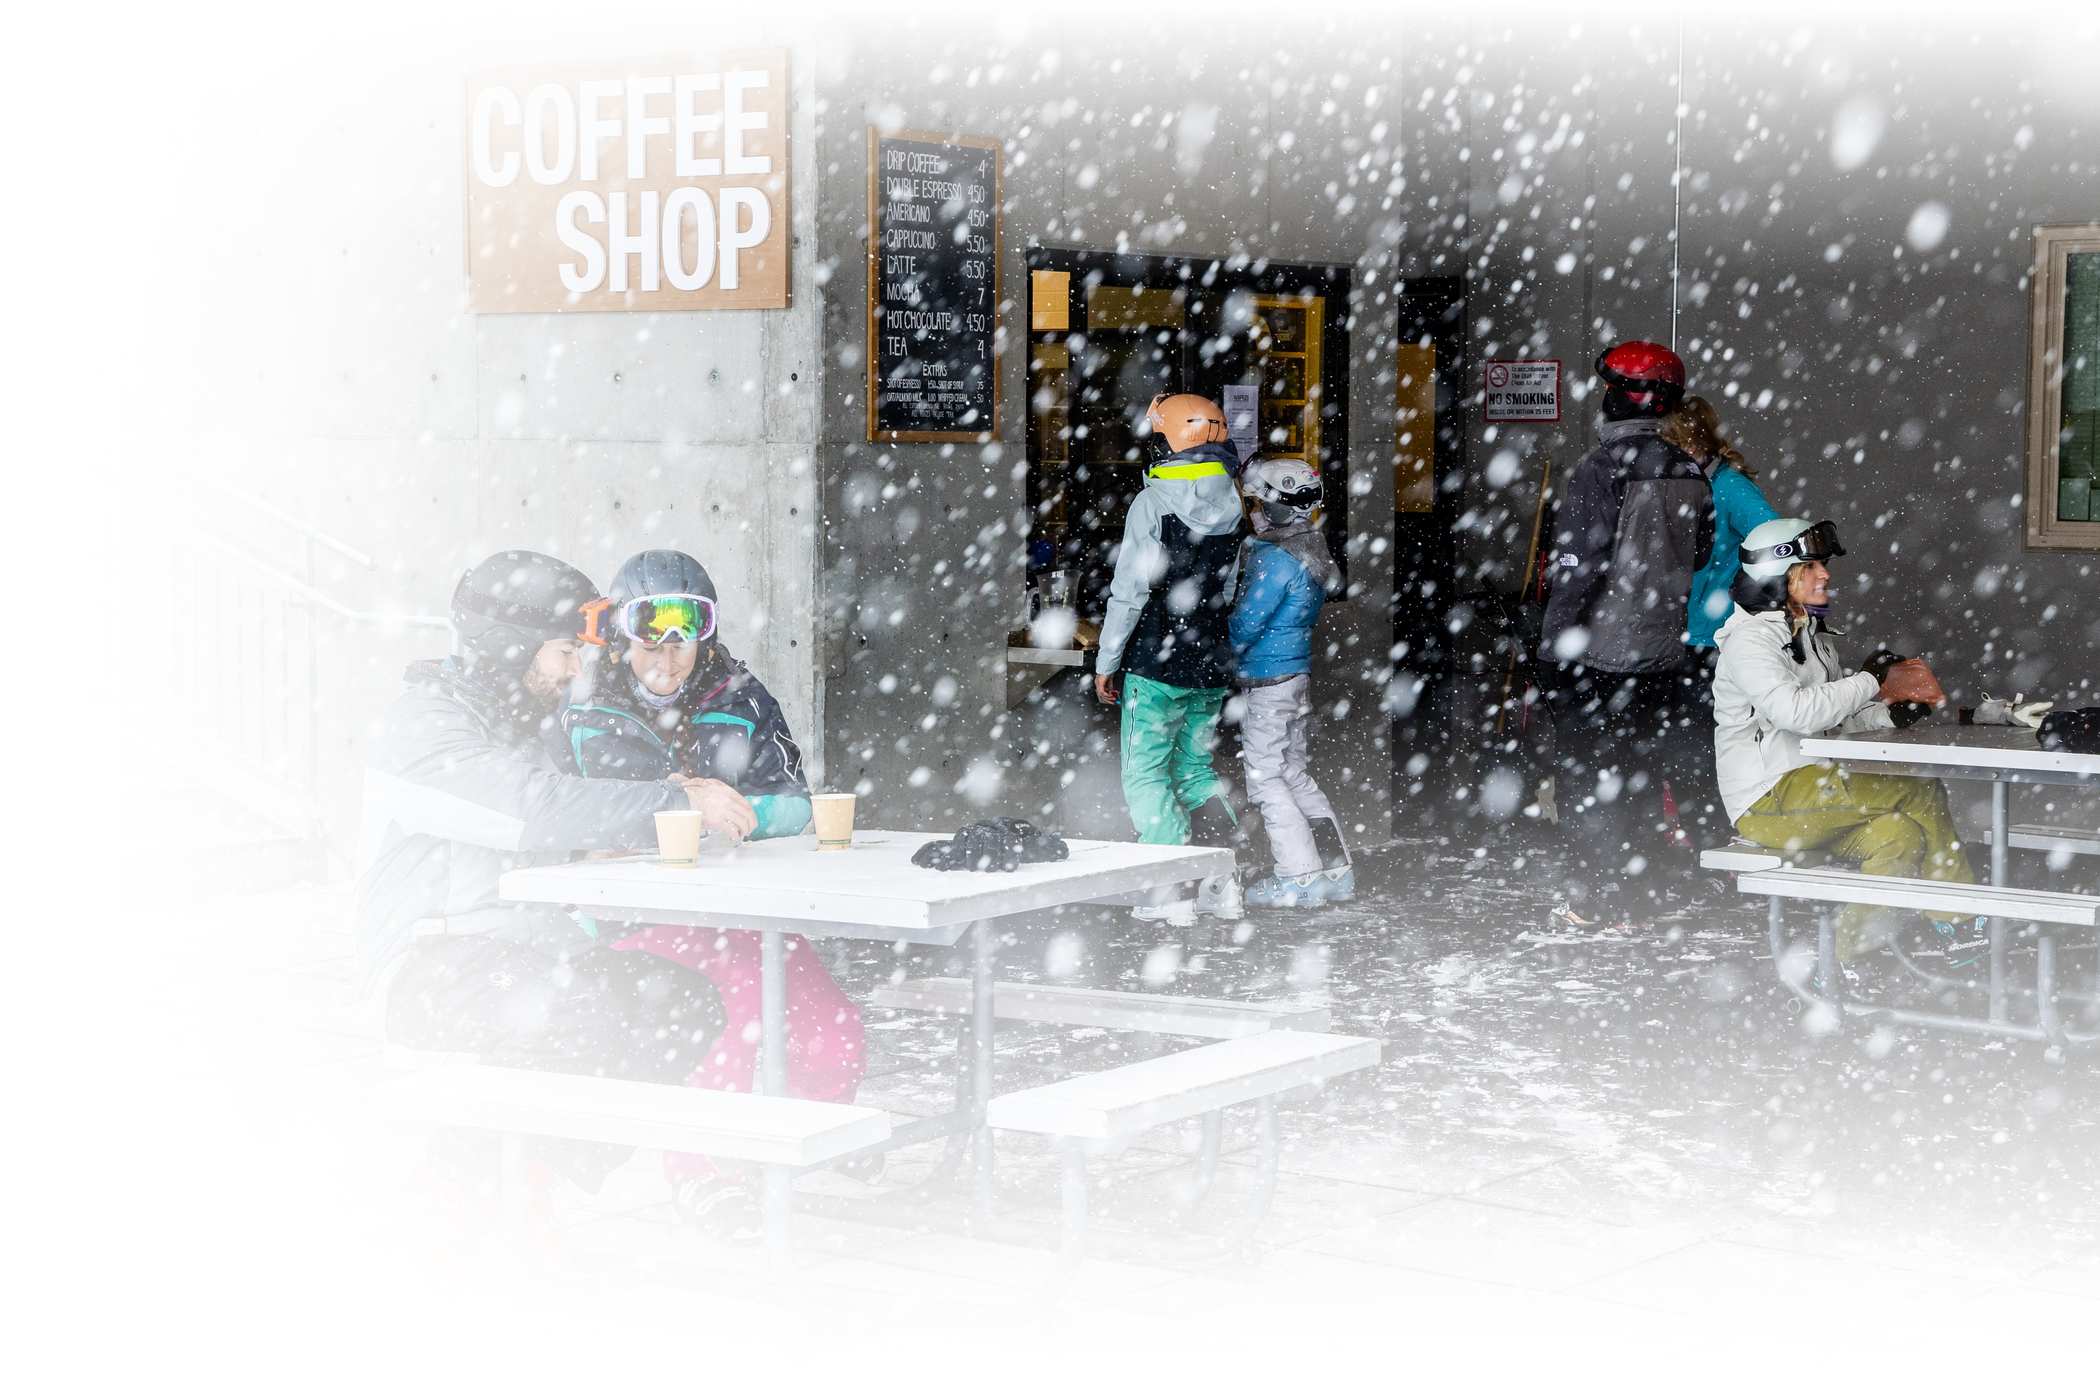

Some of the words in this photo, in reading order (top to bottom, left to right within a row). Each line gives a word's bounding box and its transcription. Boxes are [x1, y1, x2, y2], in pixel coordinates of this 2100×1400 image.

[472, 70, 772, 188] COFFEE
[887, 150, 906, 171] DRIP
[907, 152, 941, 174] COFFEE
[978, 159, 986, 179] 4
[887, 176, 919, 198] DOUBLE
[922, 180, 962, 201] ESPRESSO
[886, 202, 931, 223] AMERICANO
[556, 186, 772, 293] SHOP
[886, 229, 935, 250] CAPPUCCINO
[887, 255, 917, 275] LATTE
[966, 260, 985, 279] 5.50
[886, 282, 921, 301] MOCHA
[978, 287, 985, 305] 7
[887, 310, 905, 330] HOT
[904, 311, 951, 331] CHOCOLATE
[887, 336, 908, 357] TEA
[977, 339, 985, 360] 4
[922, 364, 948, 377] EXTRAS
[1488, 392, 1503, 405] NO
[1505, 392, 1555, 405] SMOKING
